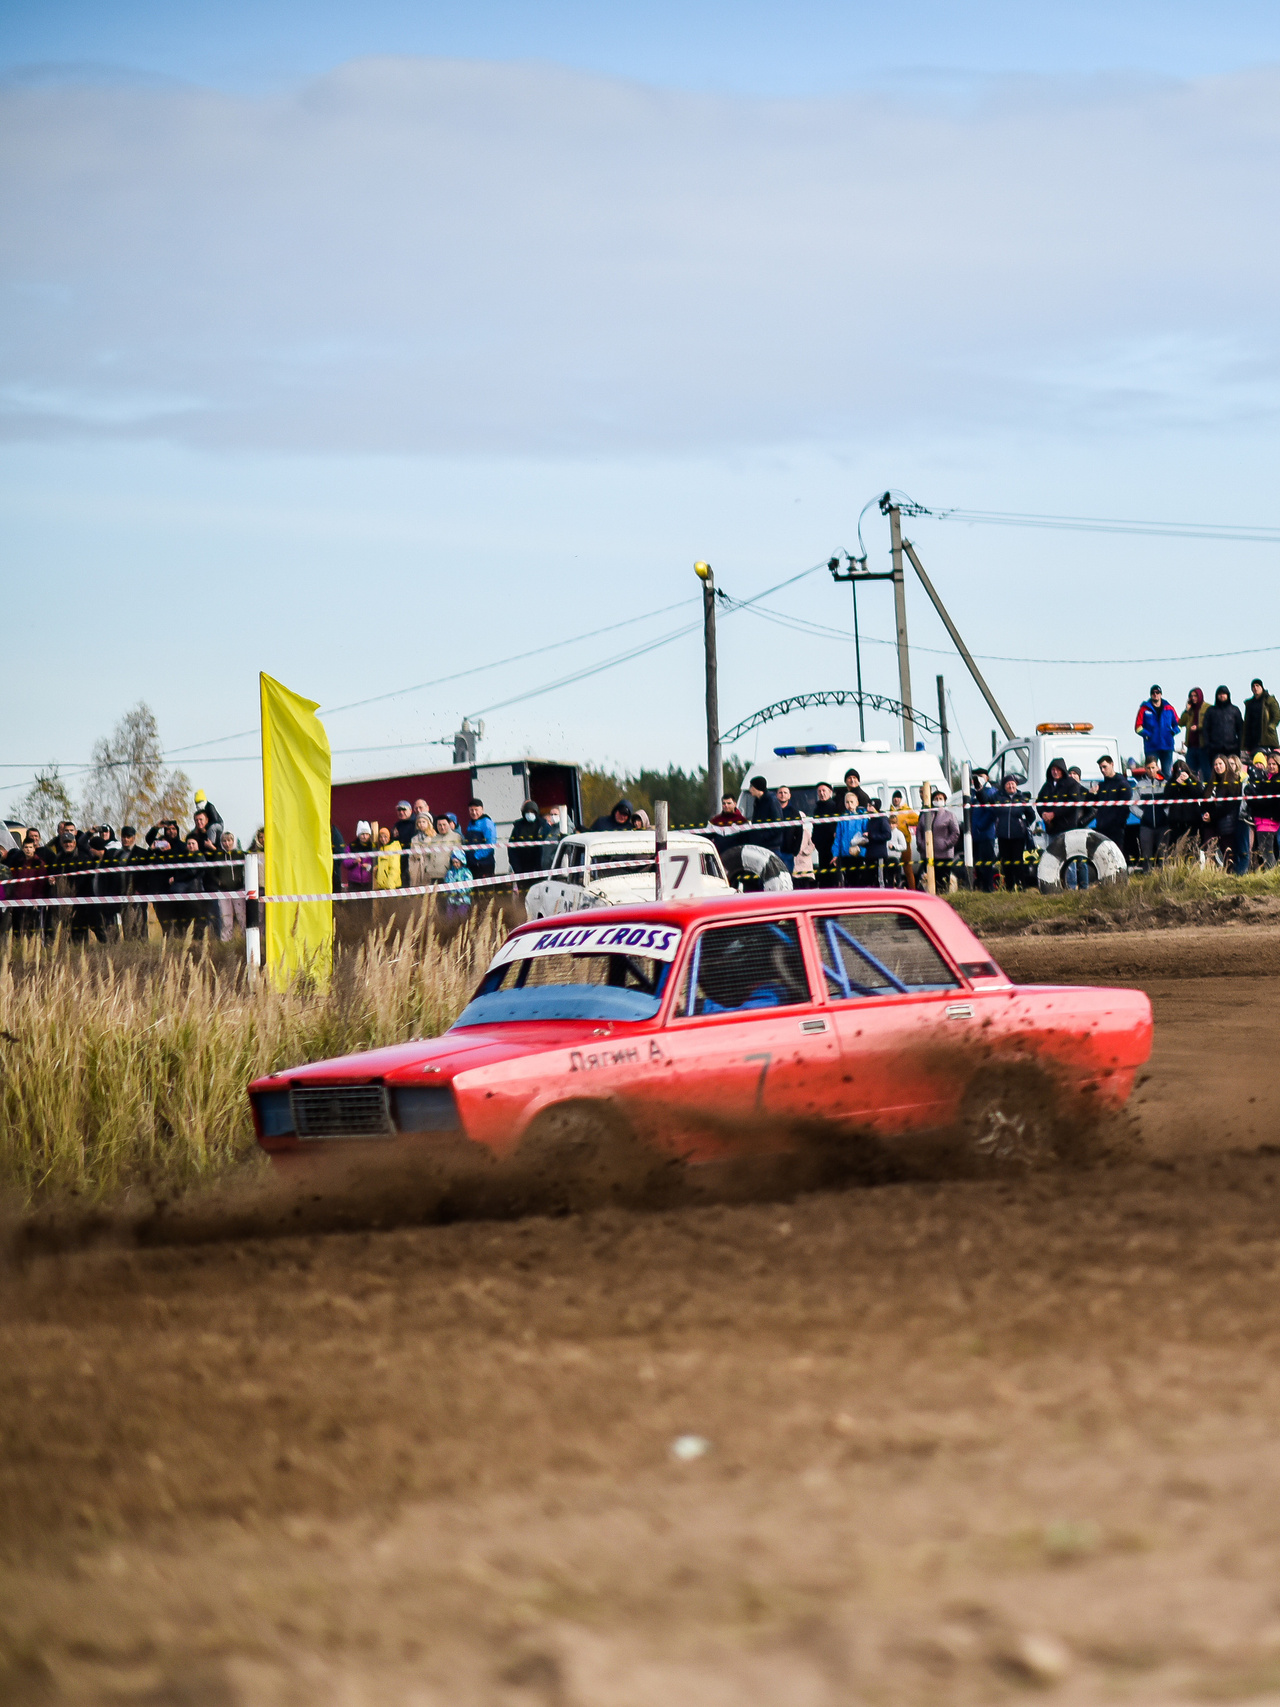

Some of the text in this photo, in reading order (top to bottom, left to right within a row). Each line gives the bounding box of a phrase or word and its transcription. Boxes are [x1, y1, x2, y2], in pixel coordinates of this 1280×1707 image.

[670, 855, 690, 890] 7
[530, 929, 598, 952] RALLY
[596, 927, 677, 951] CROSS
[744, 1052, 773, 1114] 7
